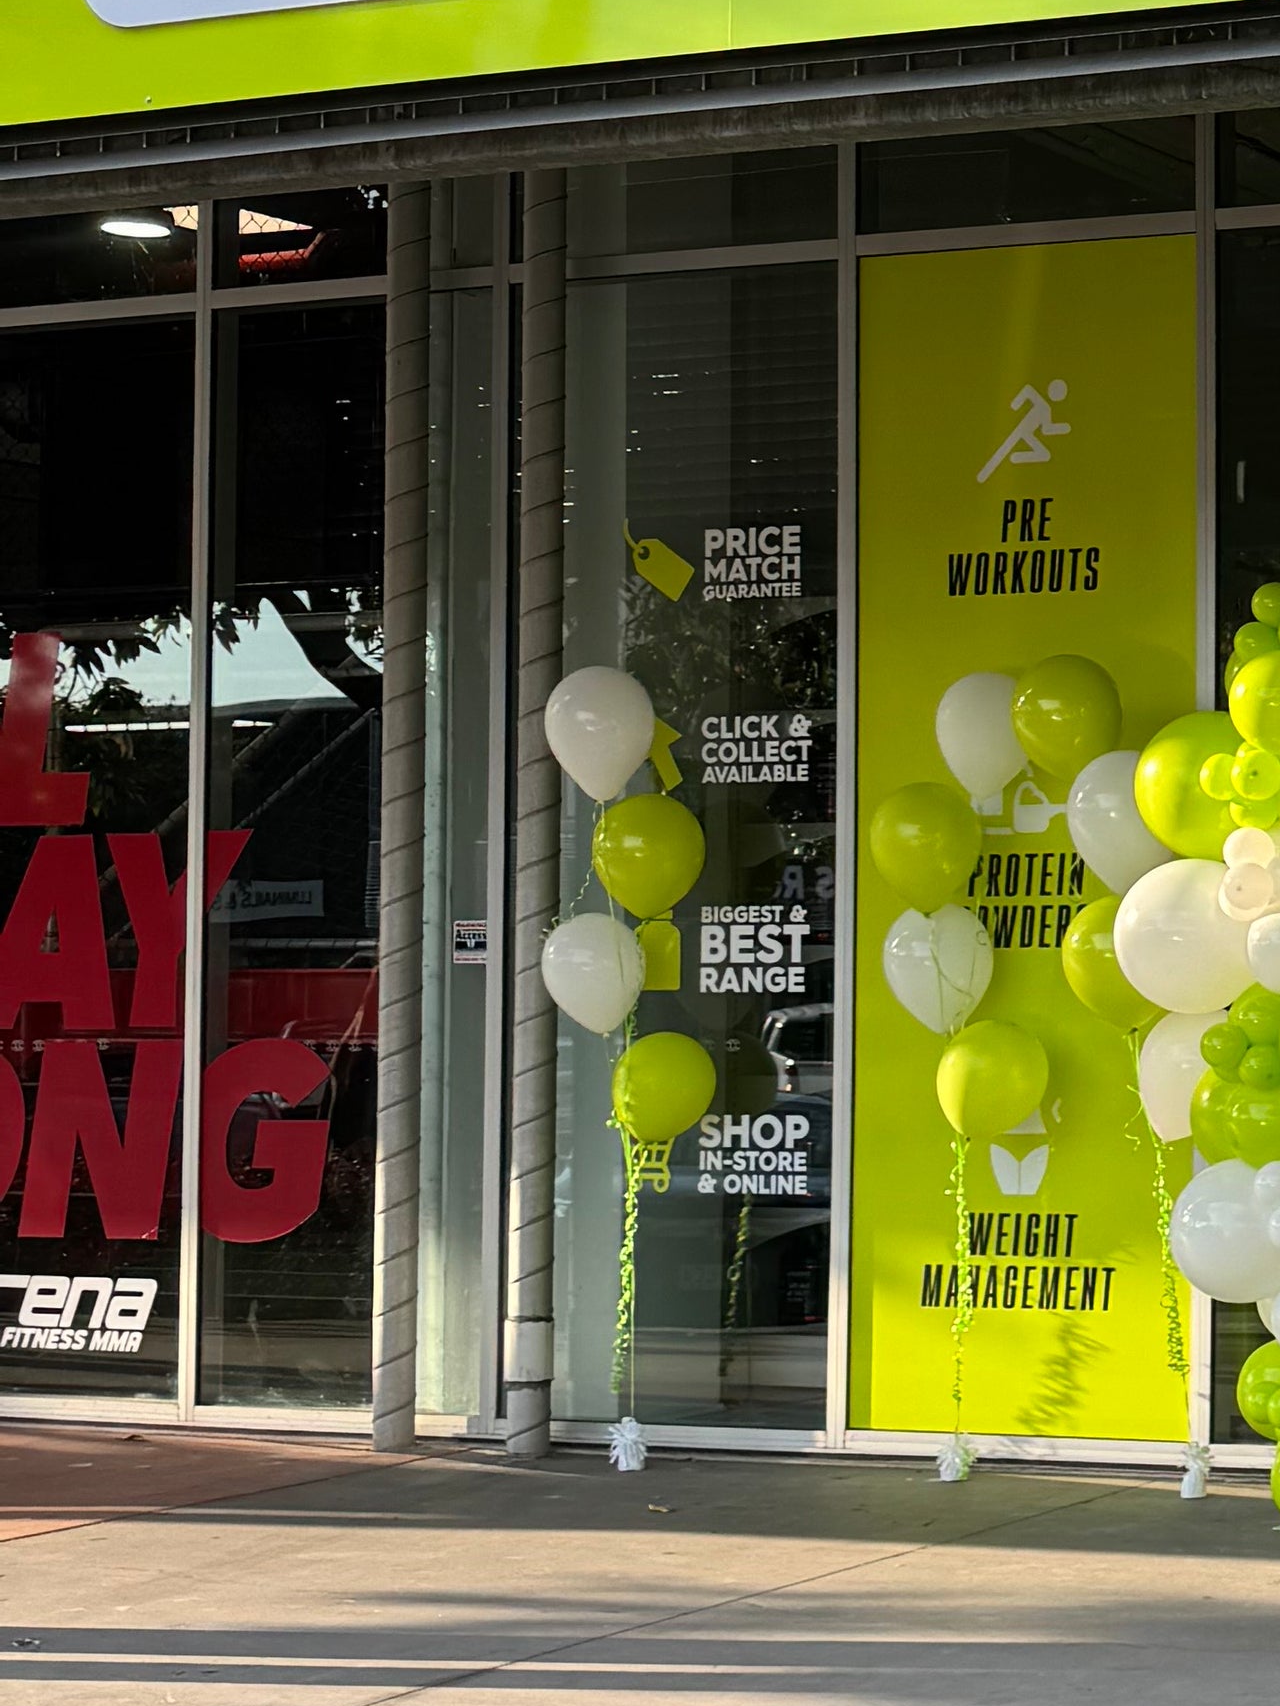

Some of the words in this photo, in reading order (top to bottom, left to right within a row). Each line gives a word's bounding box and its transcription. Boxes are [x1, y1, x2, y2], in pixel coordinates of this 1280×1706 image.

[1001, 497, 1054, 543] PRE
[704, 525, 802, 557] PRICE
[704, 555, 802, 583] MATCH
[947, 547, 1101, 597] WORKOUTS
[702, 582, 802, 600] GUARANTEE
[701, 714, 779, 739] CLICK
[788, 713, 812, 737] &
[701, 739, 813, 763] COLLECT
[701, 764, 810, 784] AVAILABLE
[967, 852, 1085, 898] PROTEIN
[700, 904, 784, 924] BIGGEST
[789, 904, 808, 923] &
[964, 903, 1088, 949] OWDER
[700, 924, 811, 964] BEST
[700, 966, 806, 993] RANGE
[699, 1113, 811, 1149] SHOP
[698, 1150, 807, 1172] IN-STORE
[697, 1173, 717, 1194] &
[723, 1173, 808, 1195] ONLINE
[967, 1212, 1079, 1258] WEIGHT
[0, 1326, 88, 1352] FITNESS
[89, 1328, 143, 1354] MMA
